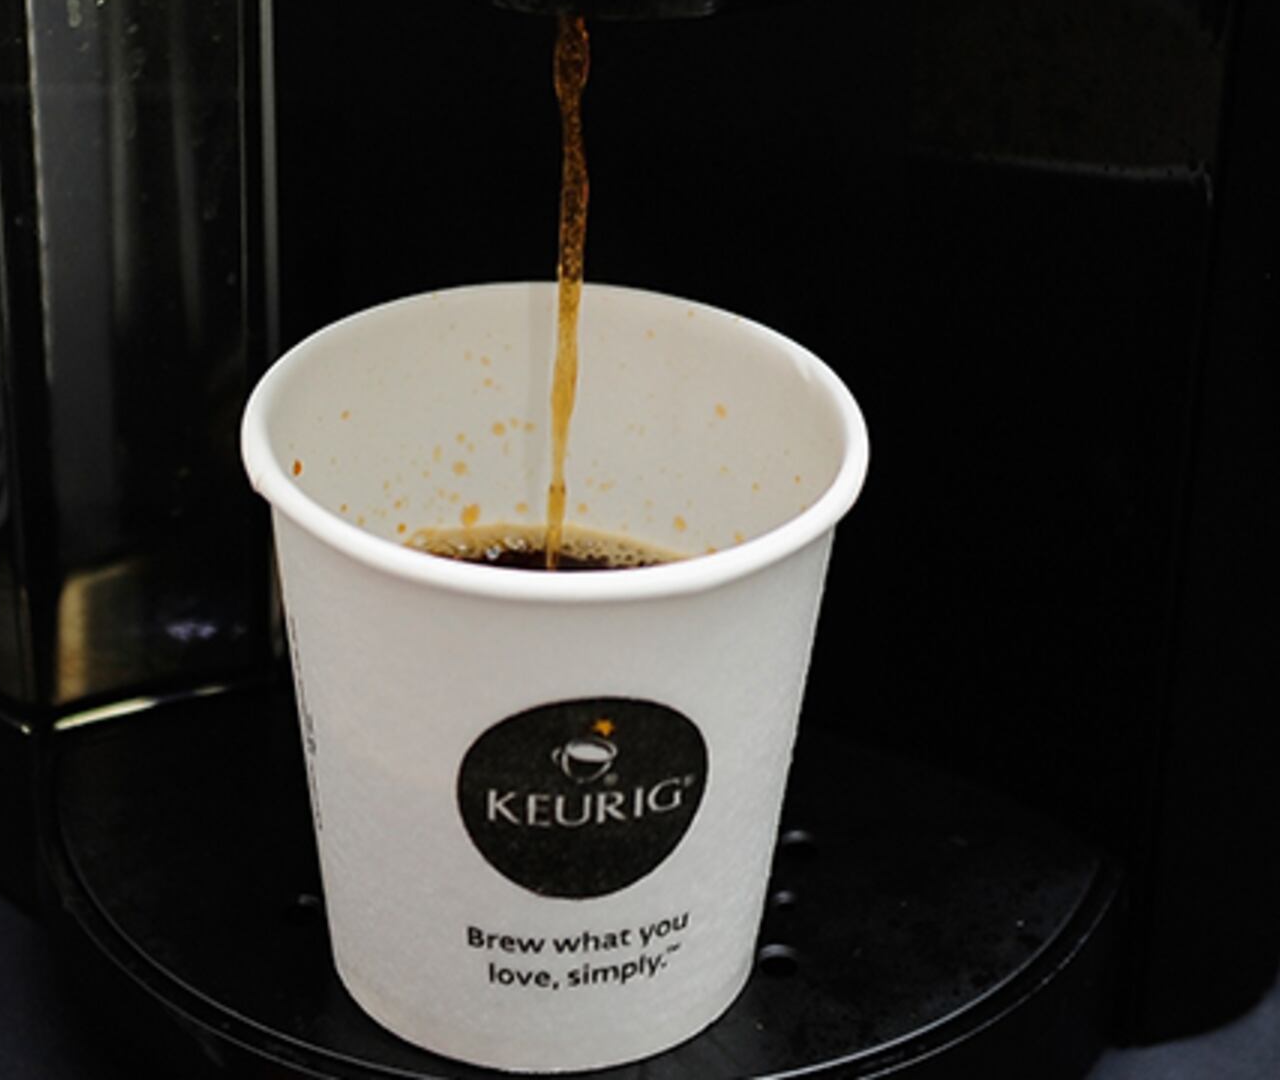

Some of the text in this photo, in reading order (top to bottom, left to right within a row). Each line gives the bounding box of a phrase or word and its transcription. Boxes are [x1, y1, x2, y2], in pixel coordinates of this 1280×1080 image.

[486, 777, 683, 827] KEURIG
[467, 912, 689, 954] Brew what you
[488, 962, 560, 990] love,
